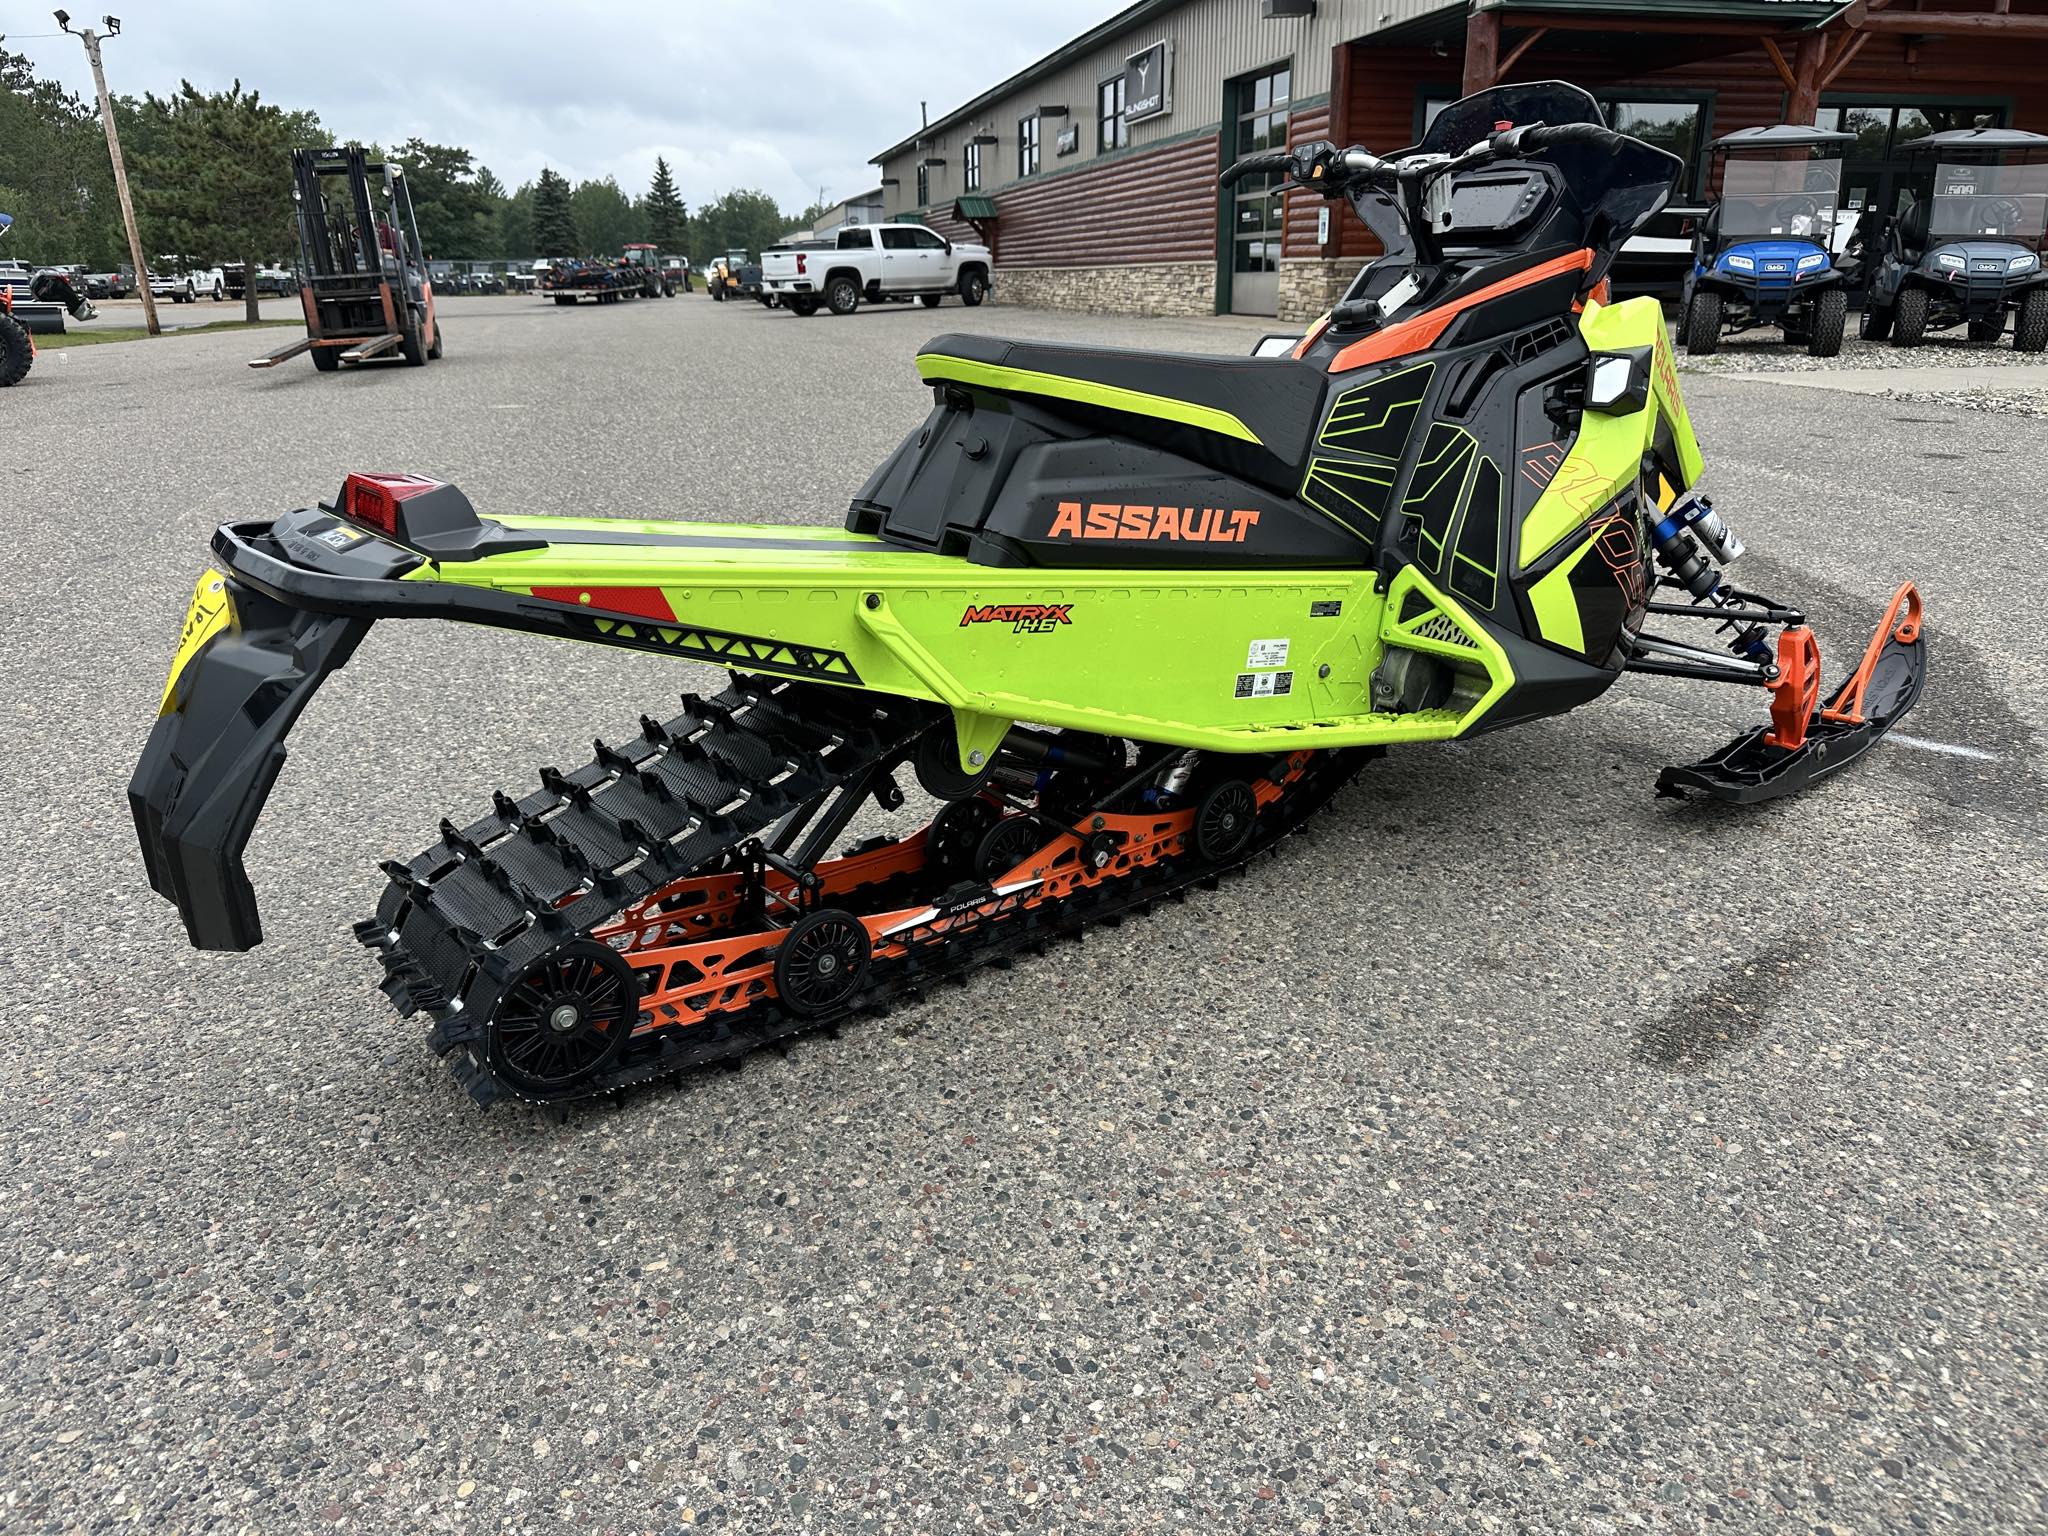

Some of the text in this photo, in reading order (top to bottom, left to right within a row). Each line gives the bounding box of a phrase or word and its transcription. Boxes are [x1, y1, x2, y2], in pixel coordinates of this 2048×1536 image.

[1047, 502, 1261, 542] ASSAULT
[959, 604, 1075, 627] MATRYX
[1013, 619, 1058, 633] 146
[950, 896, 986, 913] POLARIS
